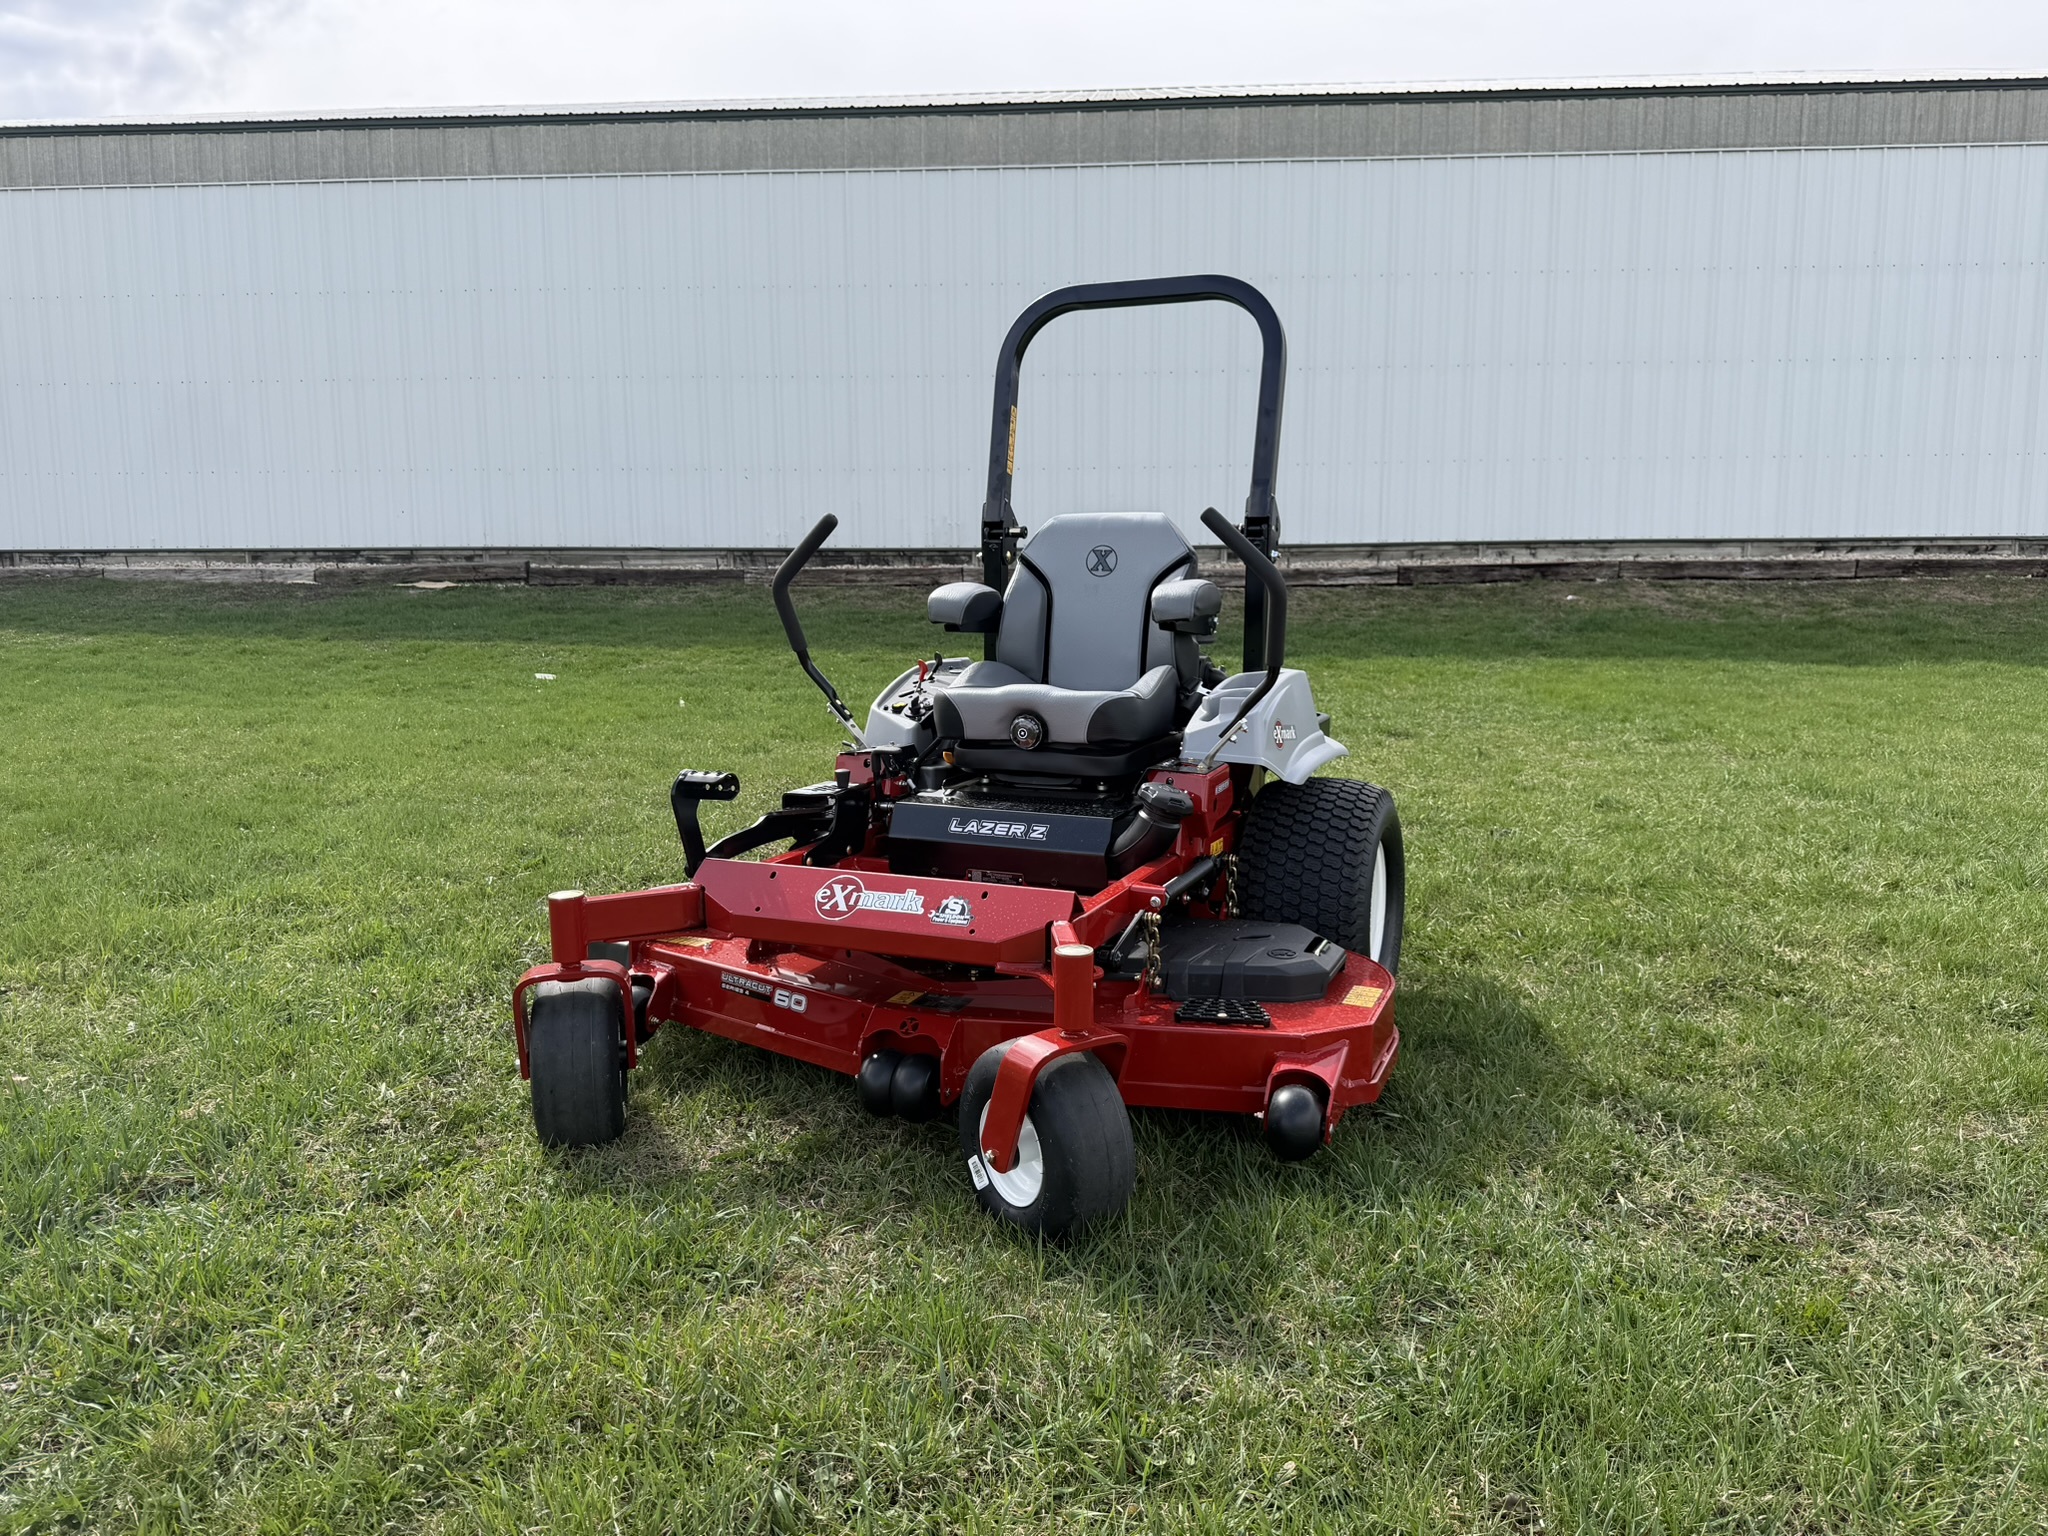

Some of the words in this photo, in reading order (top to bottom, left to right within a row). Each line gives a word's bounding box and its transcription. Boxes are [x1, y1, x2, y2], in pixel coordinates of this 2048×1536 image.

[1273, 725, 1297, 744] eXmark
[949, 818, 1026, 838] LAZER
[1028, 824, 1049, 840] Z
[816, 882, 924, 913] eXmark
[721, 971, 773, 995] ULTRACUT
[721, 982, 744, 994] SERIES
[774, 988, 809, 1013] 60
